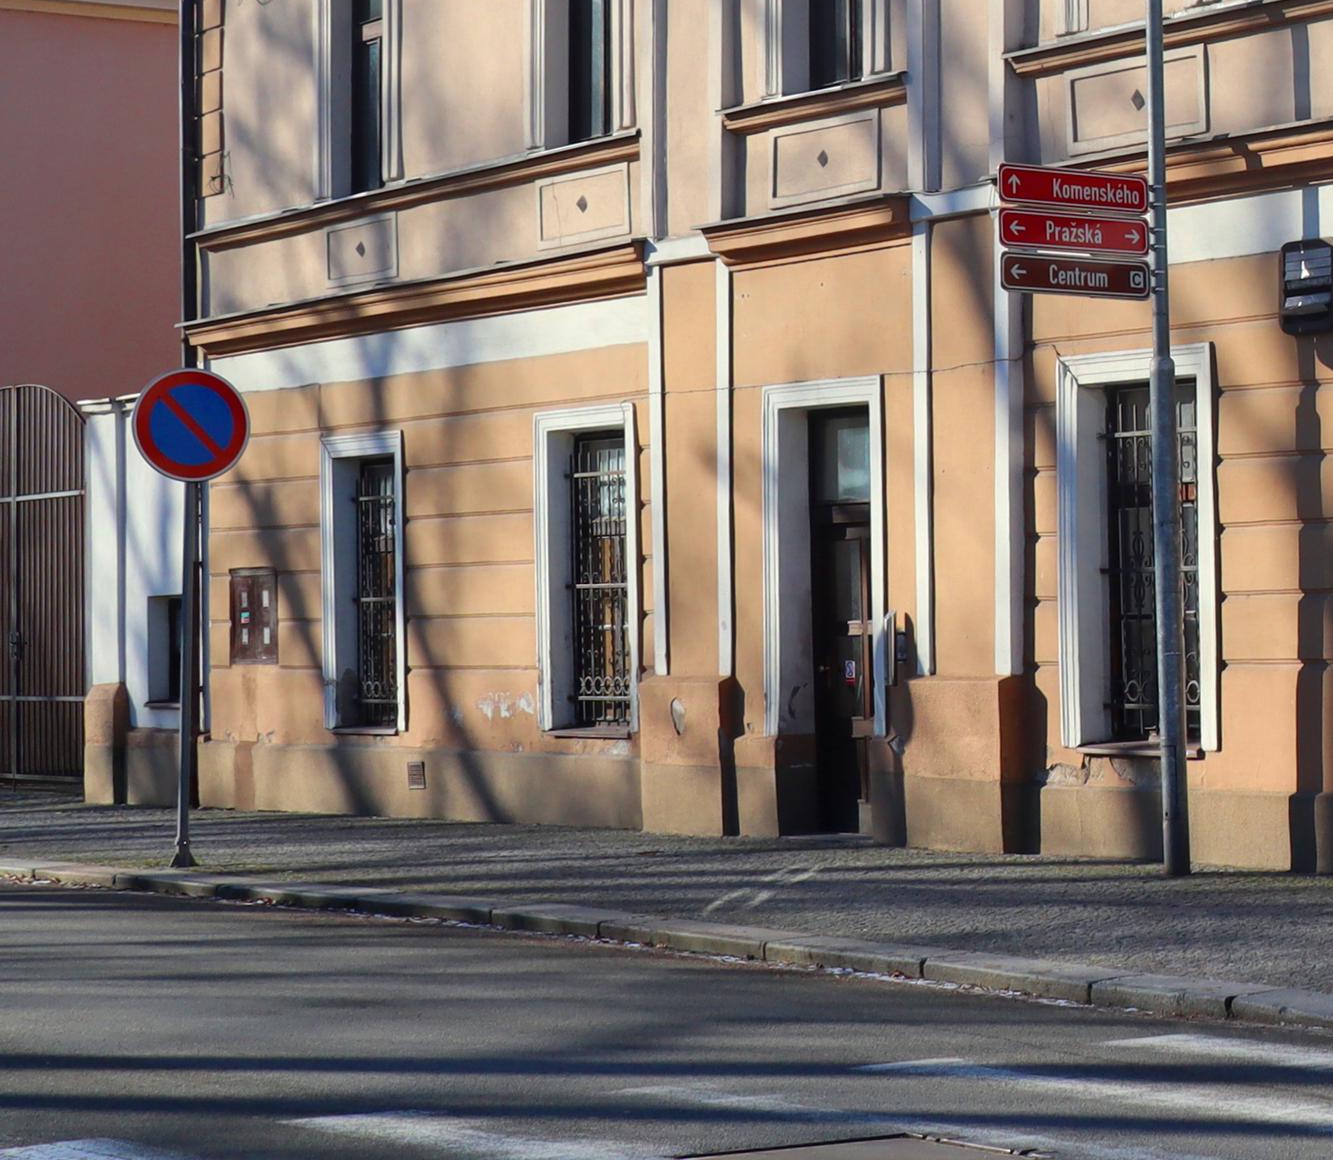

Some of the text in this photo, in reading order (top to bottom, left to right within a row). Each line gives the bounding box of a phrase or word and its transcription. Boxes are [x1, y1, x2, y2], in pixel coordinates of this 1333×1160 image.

[1053, 178, 1140, 205] Komenského
[1046, 220, 1102, 244] Pražská
[1050, 264, 1108, 288] Centrum
